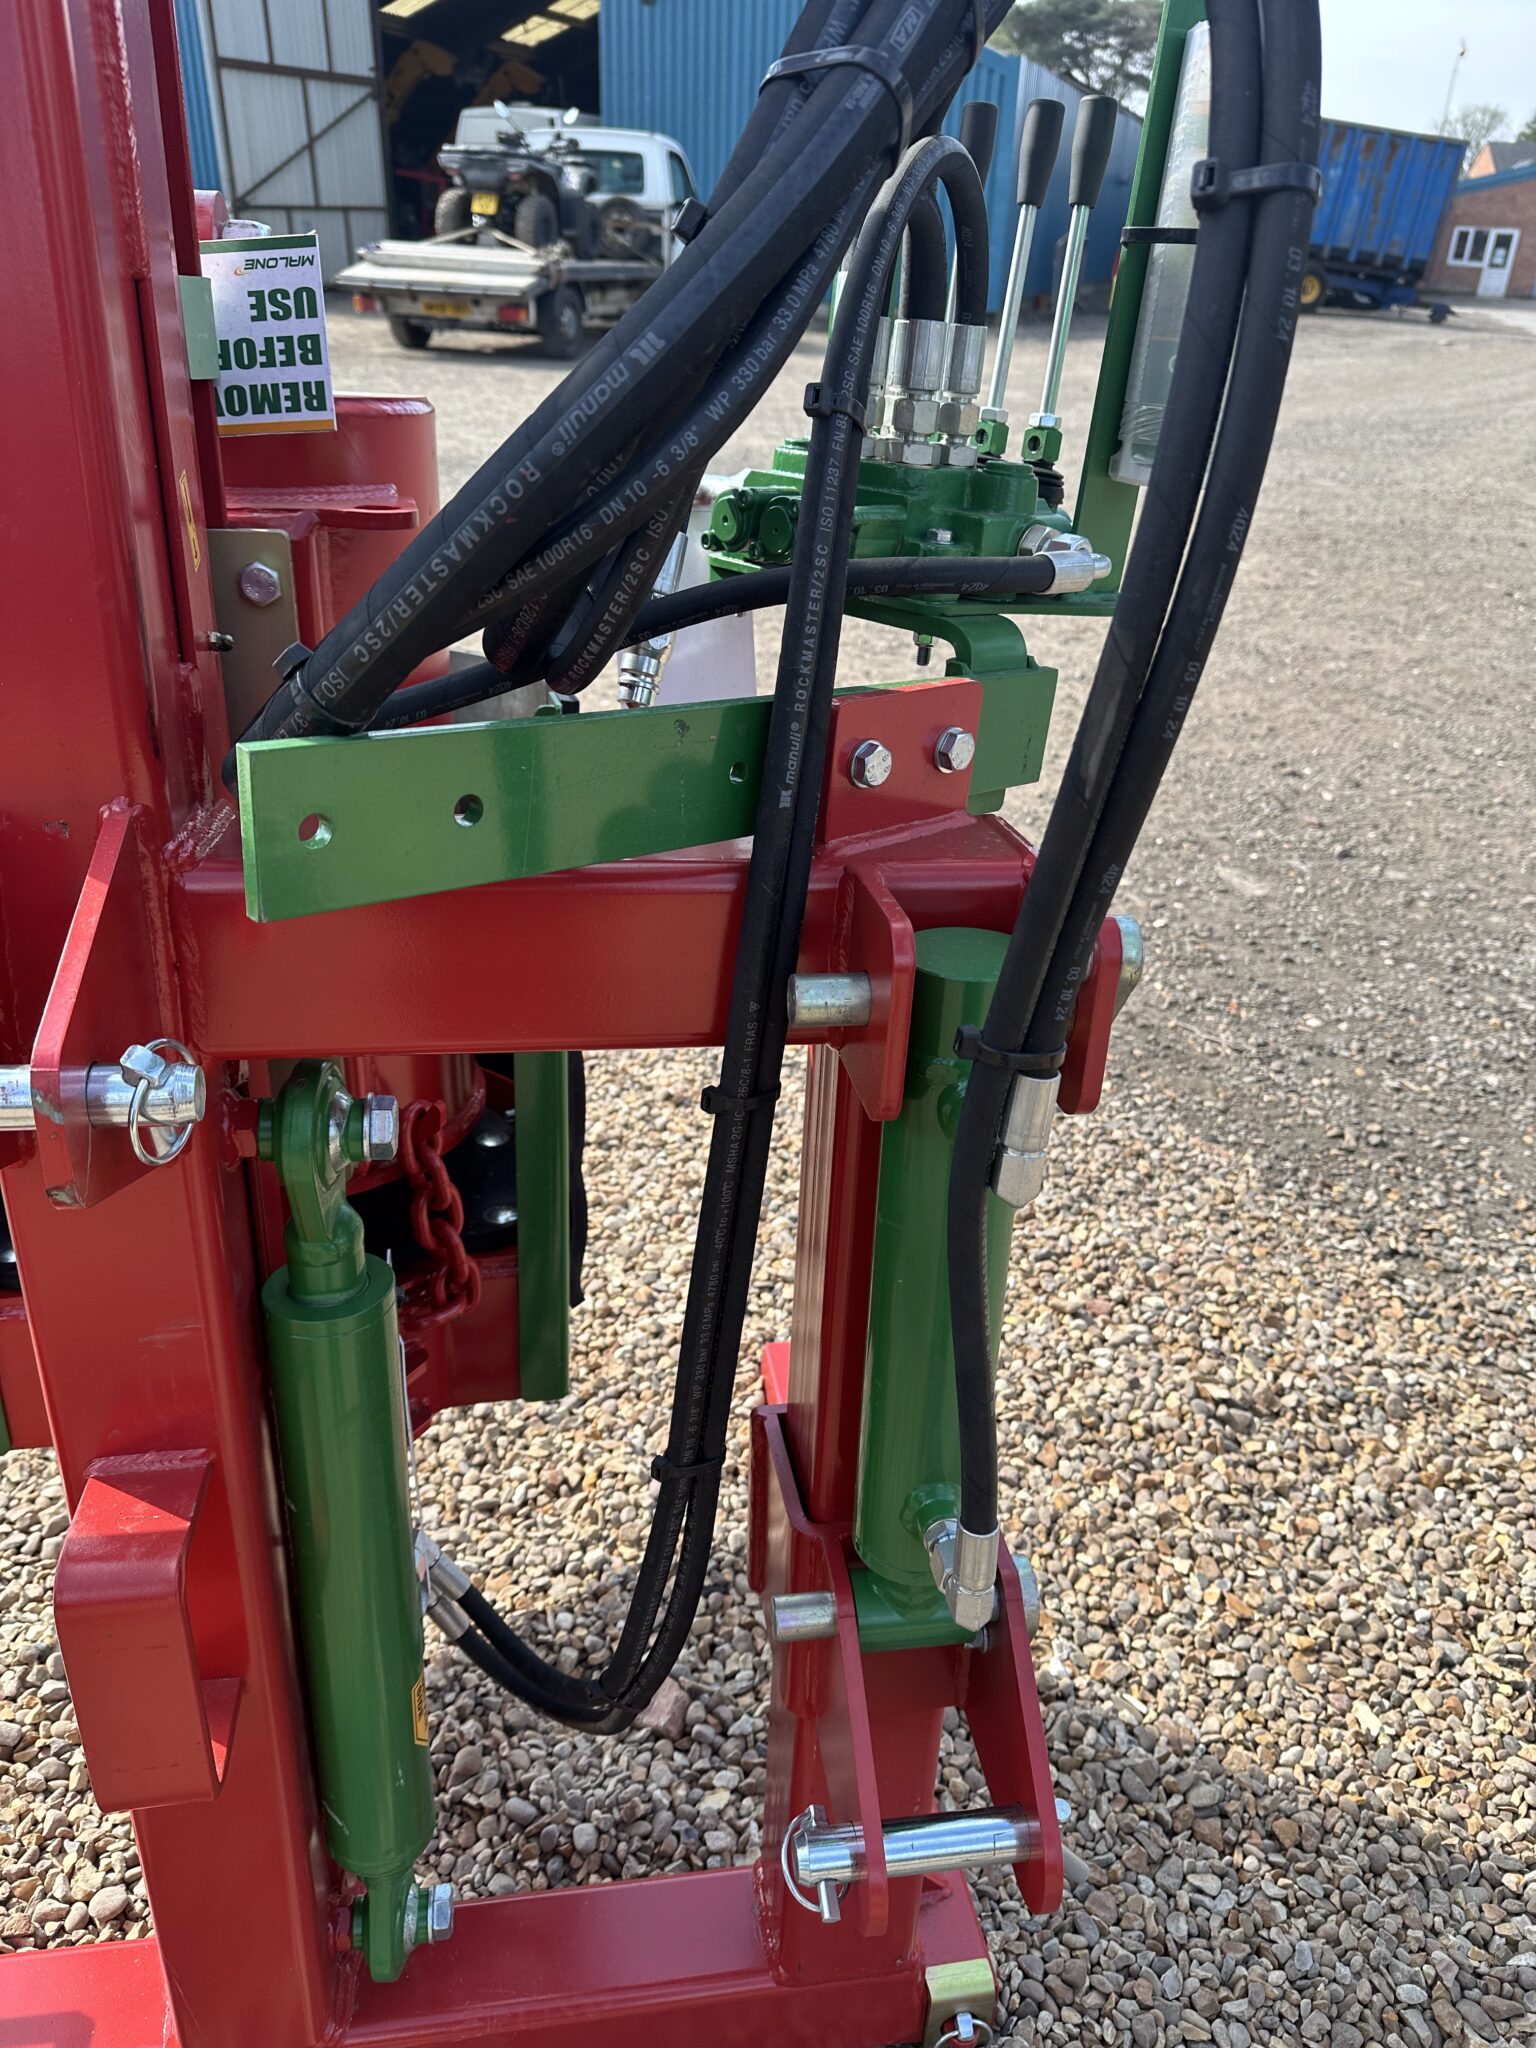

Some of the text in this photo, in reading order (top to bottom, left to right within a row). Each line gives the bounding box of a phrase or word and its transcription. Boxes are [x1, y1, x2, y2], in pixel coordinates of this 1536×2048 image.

[244, 254, 315, 271] MALONE
[878, 238, 892, 257] 10
[871, 256, 885, 279] DN
[248, 286, 319, 322] USE
[856, 282, 878, 336] 100R16
[219, 333, 323, 371] BEFOR
[846, 336, 864, 366] SAE
[506, 562, 538, 590] SAE
[535, 526, 594, 572] 100R16
[599, 498, 627, 525] DN
[625, 480, 648, 503] 10
[651, 459, 670, 480] -6
[705, 390, 731, 422] WP
[731, 357, 760, 391] 330
[757, 334, 779, 361] bar
[771, 293, 802, 331] 33.0
[797, 263, 820, 299] MPa
[815, 220, 841, 259] 4780
[832, 429, 847, 453] EN
[824, 459, 841, 503] 11237
[820, 506, 834, 535] ISO
[1227, 506, 1248, 552] 4024
[354, 461, 541, 663] ROCKMASTER/2SC
[569, 548, 650, 680] ROCKMASTER/2SC
[648, 508, 669, 539] ISO
[794, 542, 829, 713] ROCKMASTER/2SC
[321, 666, 350, 698] ISO
[1099, 863, 1120, 895] 4024
[743, 1021, 758, 1052] FRAS
[726, 1143, 740, 1174] MSHA
[707, 1273, 720, 1298] 4780
[703, 1301, 715, 1325] MPa
[695, 1361, 706, 1384] 330
